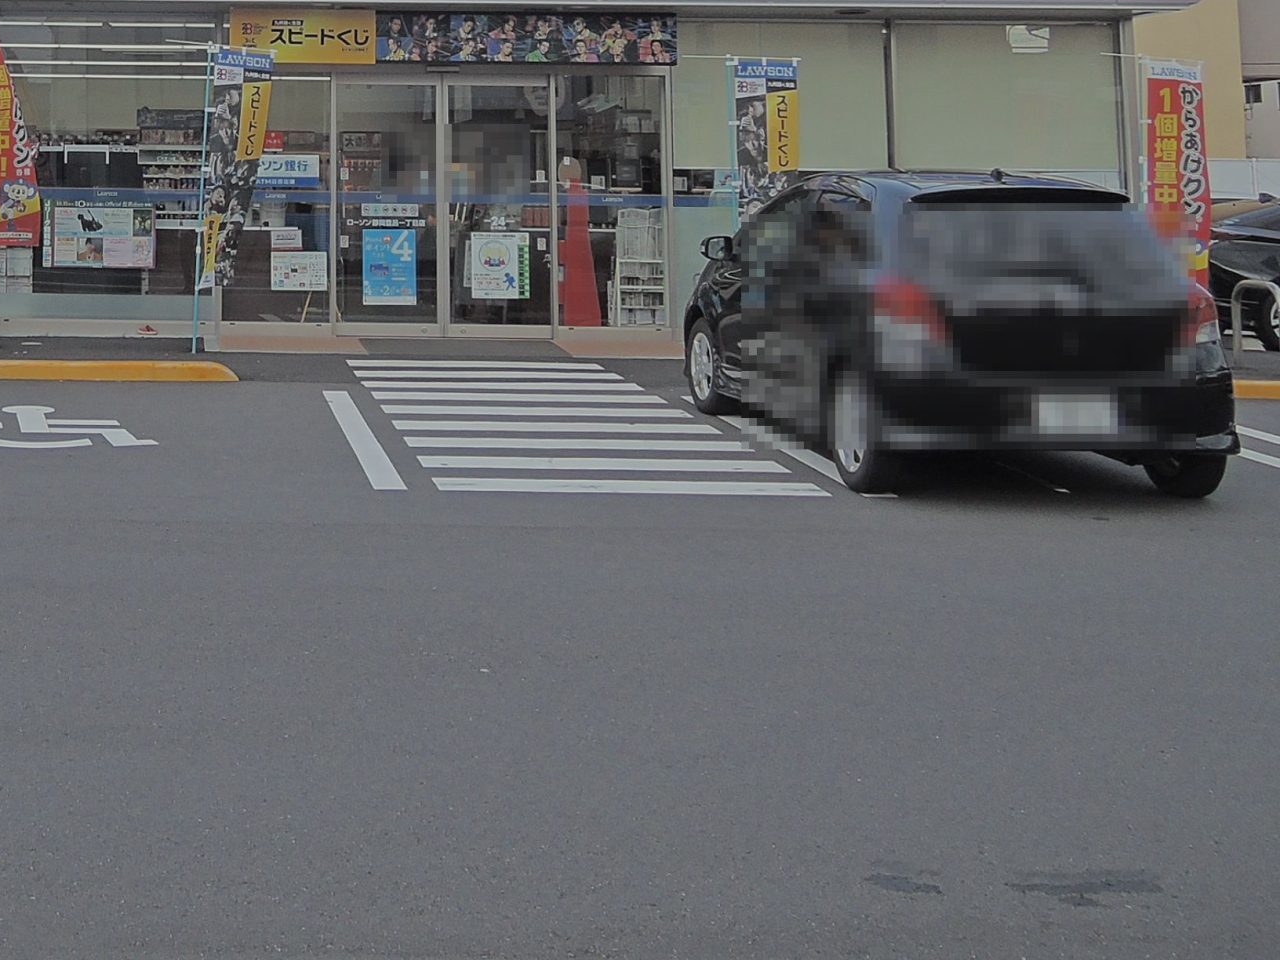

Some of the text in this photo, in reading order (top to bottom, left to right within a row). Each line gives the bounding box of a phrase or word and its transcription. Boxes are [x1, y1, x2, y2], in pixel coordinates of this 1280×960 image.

[270, 28, 370, 45] スピードくじ
[218, 53, 270, 68] LAWSON
[738, 65, 794, 77] LAWSON
[245, 86, 261, 156] スピードくじ
[776, 95, 790, 167] スピードくじ
[490, 216, 507, 227] 24
